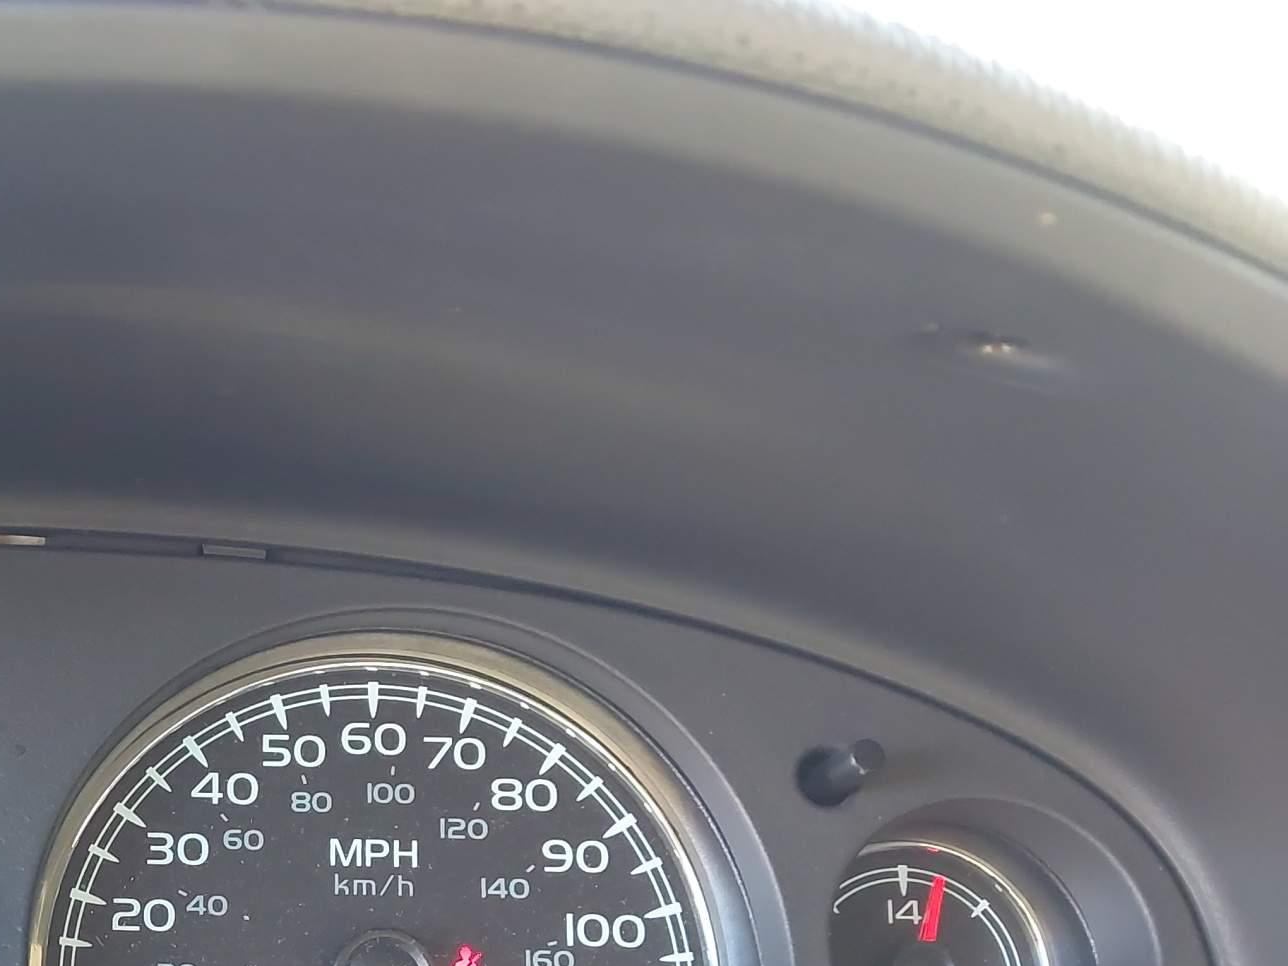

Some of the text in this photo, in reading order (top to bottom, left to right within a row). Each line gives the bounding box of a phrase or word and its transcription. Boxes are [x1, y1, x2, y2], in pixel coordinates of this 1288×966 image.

[262, 734, 326, 768] 50
[340, 722, 407, 756] 60
[423, 736, 486, 770] 70
[190, 772, 259, 806] 40
[291, 791, 332, 813] 80
[367, 782, 415, 804] 100
[491, 778, 558, 812] 80
[223, 829, 264, 851] 60
[439, 817, 489, 840] 120
[146, 832, 209, 866] 30
[329, 838, 418, 869] MPH
[541, 839, 609, 874] 90
[334, 873, 414, 897] km/h
[480, 877, 530, 899] 140
[112, 897, 176, 932] 20
[186, 895, 228, 916] 40
[887, 899, 923, 925] 14
[565, 913, 646, 948] 100
